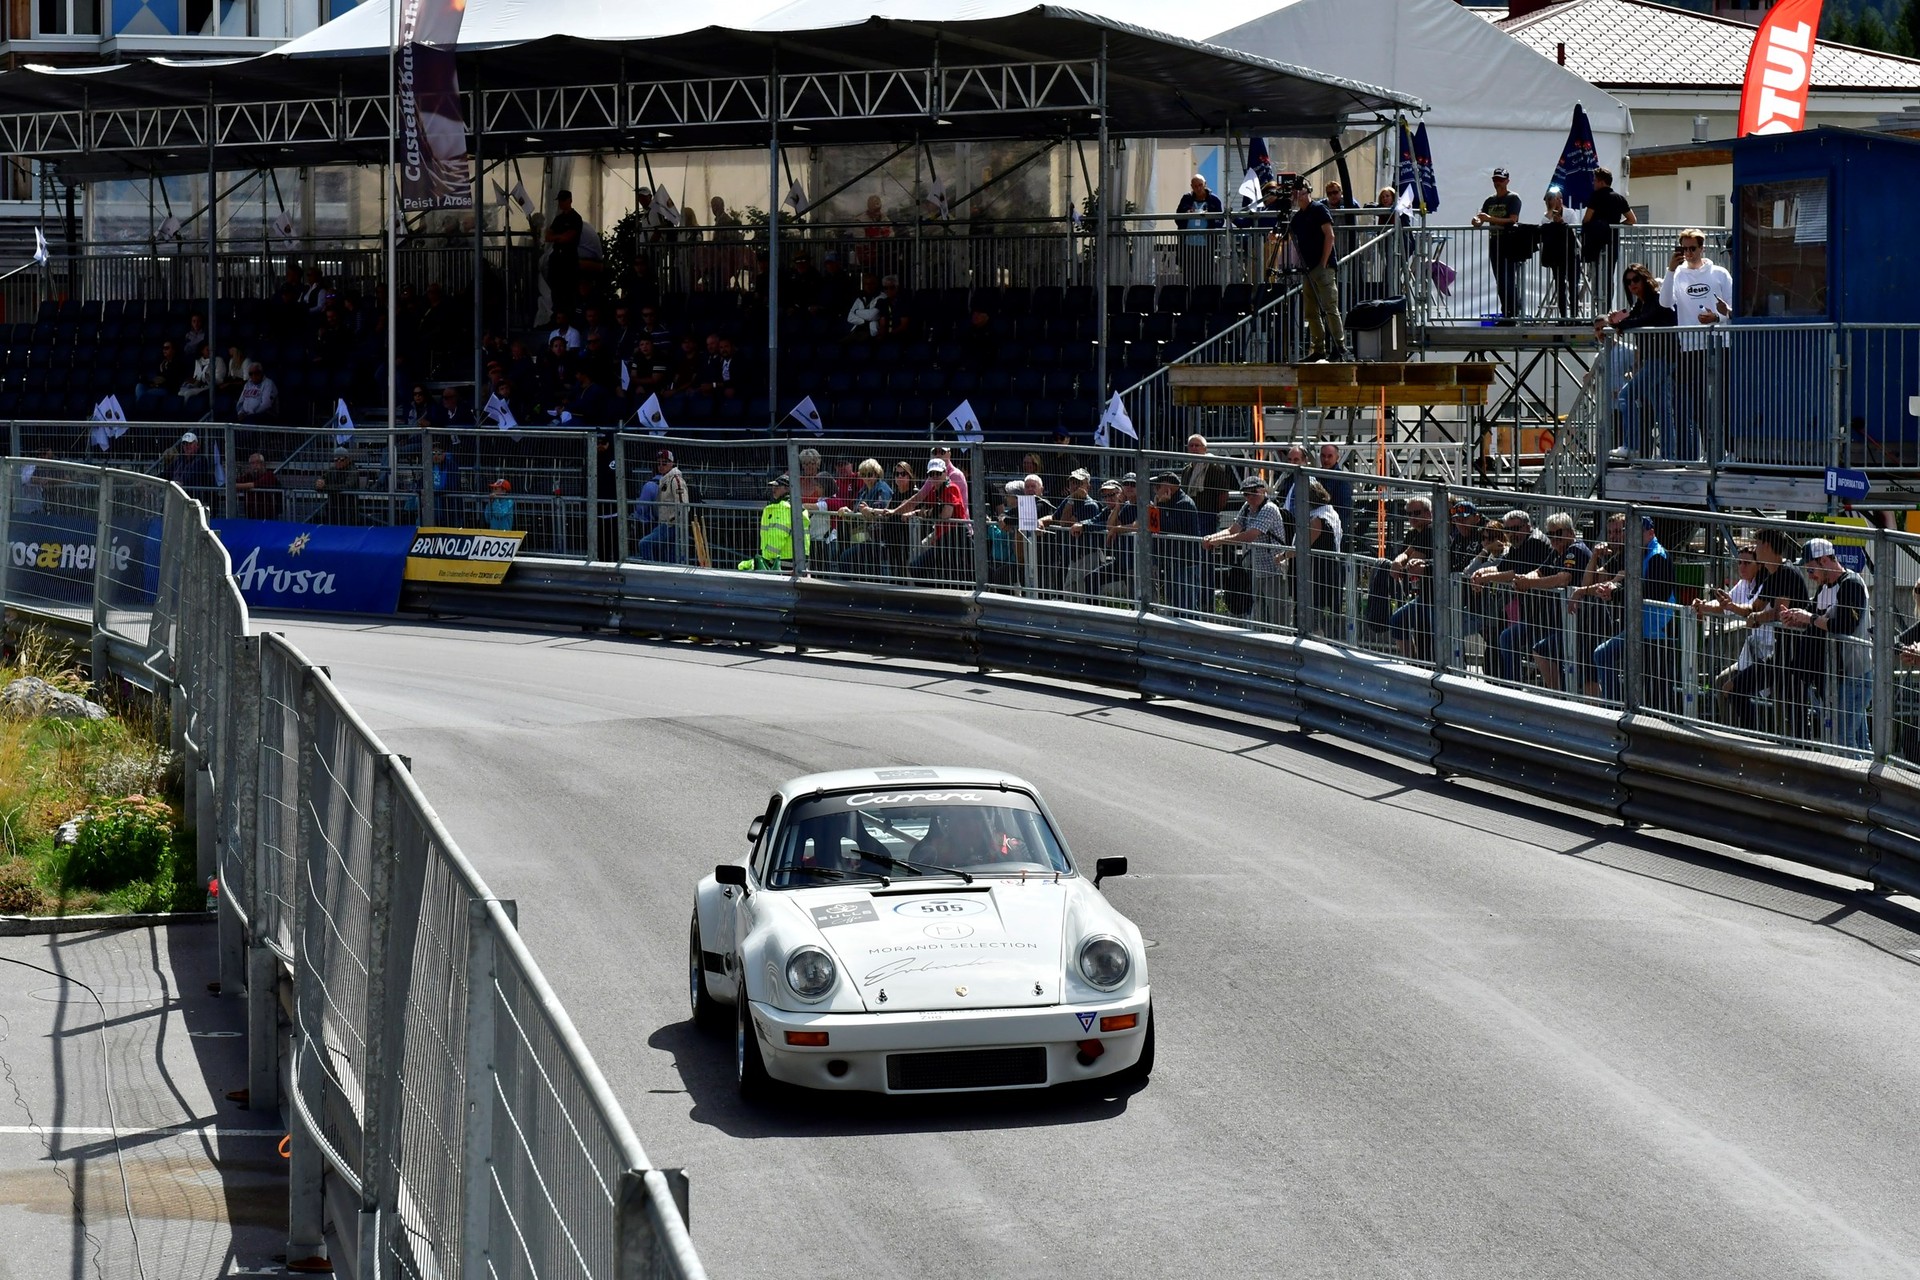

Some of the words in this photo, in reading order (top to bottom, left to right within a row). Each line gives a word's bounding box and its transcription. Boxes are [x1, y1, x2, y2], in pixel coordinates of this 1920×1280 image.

[404, 0, 419, 27] Ih
[402, 91, 420, 182] Castelli
[403, 197, 434, 209] Peist
[1687, 286, 1709, 294] deus
[1837, 477, 1865, 490] INFORMATION
[410, 537, 472, 557] BRUNOLD
[470, 540, 516, 559] AROSA
[233, 546, 337, 595] Arosa
[846, 792, 983, 807] Carrera
[920, 904, 964, 914] 505
[868, 943, 944, 956] MORANDI
[950, 942, 1038, 950] SELECTION
